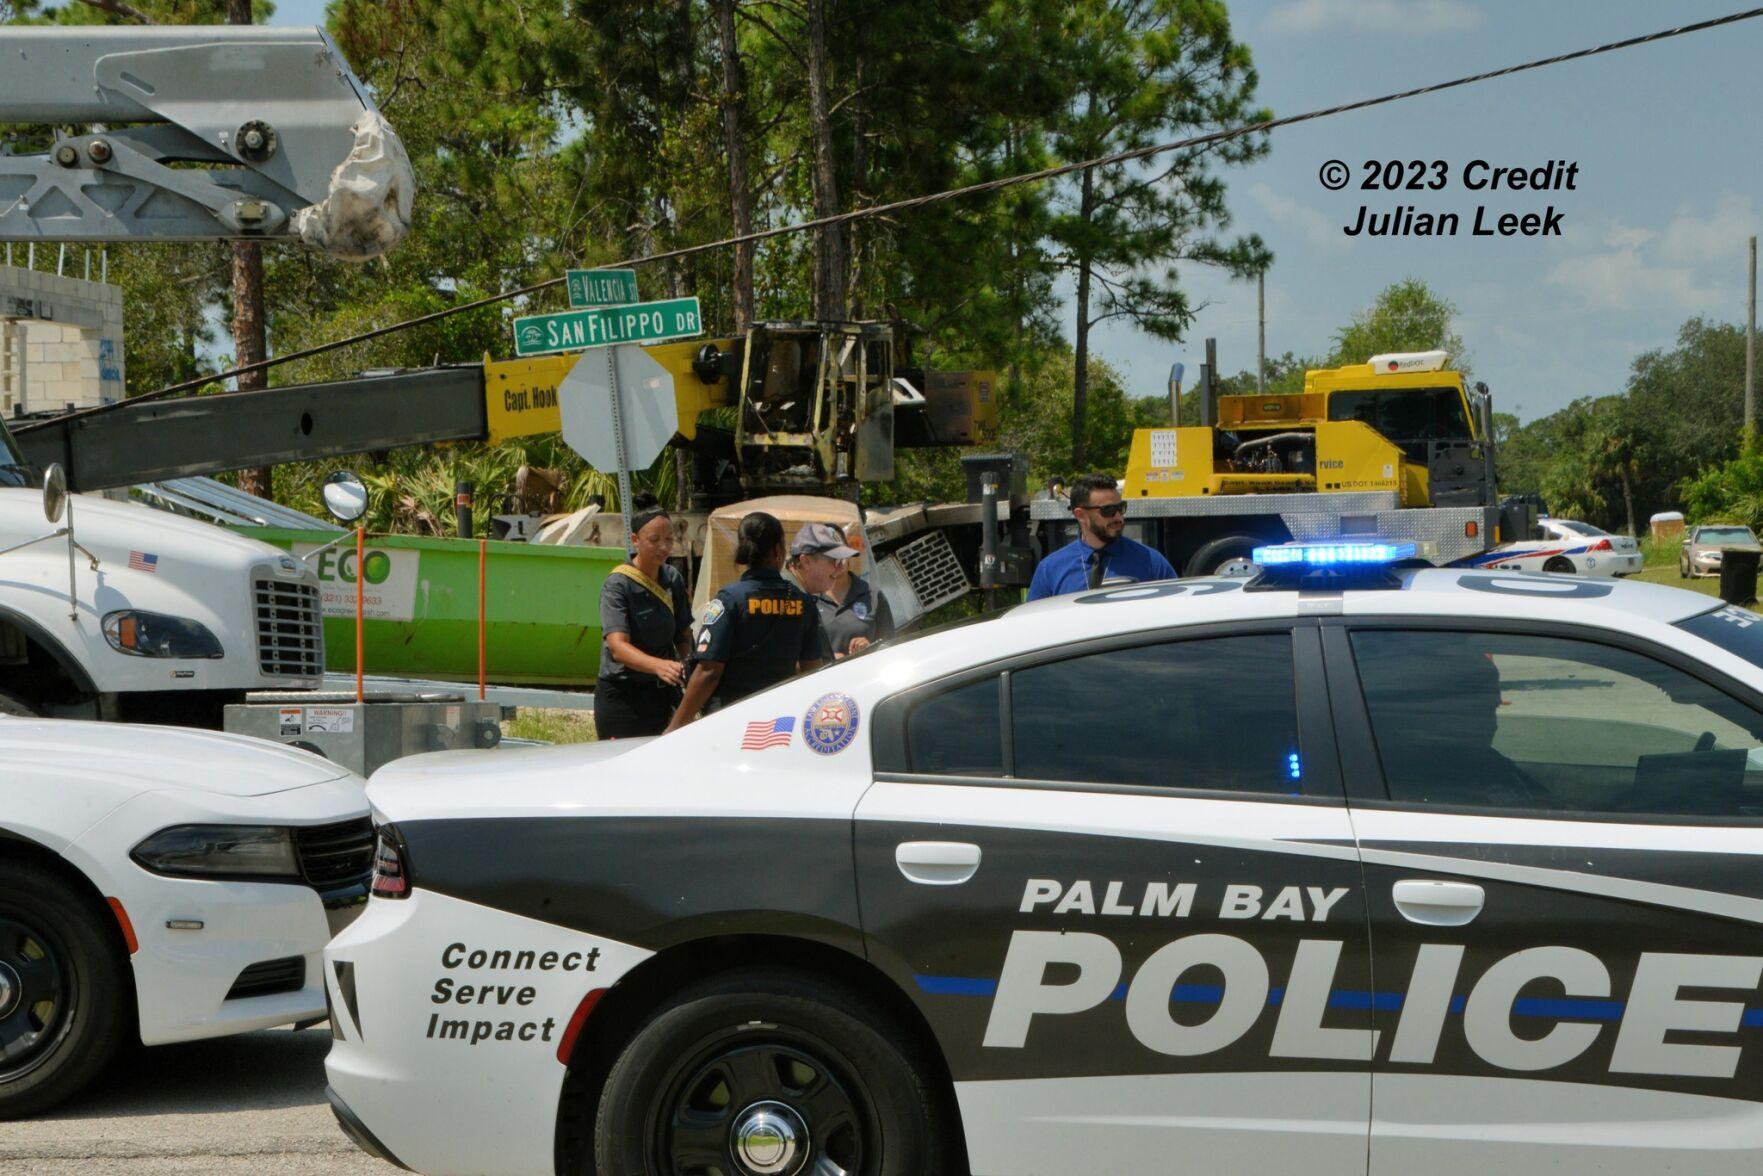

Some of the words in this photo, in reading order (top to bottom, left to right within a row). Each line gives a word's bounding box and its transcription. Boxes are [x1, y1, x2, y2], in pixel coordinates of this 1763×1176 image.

[582, 275, 626, 303] VALENCIA
[676, 313, 696, 332] DR
[504, 390, 531, 413] Capt.
[533, 386, 558, 409] Hook
[319, 549, 390, 584] ECO
[748, 598, 804, 616] POLICE
[1019, 878, 1198, 918] PALM
[1219, 884, 1350, 922] BAY
[441, 942, 601, 972] Connect
[430, 978, 537, 1006] Serve
[982, 929, 1763, 1079] POLICE
[426, 1013, 555, 1045] Impact
